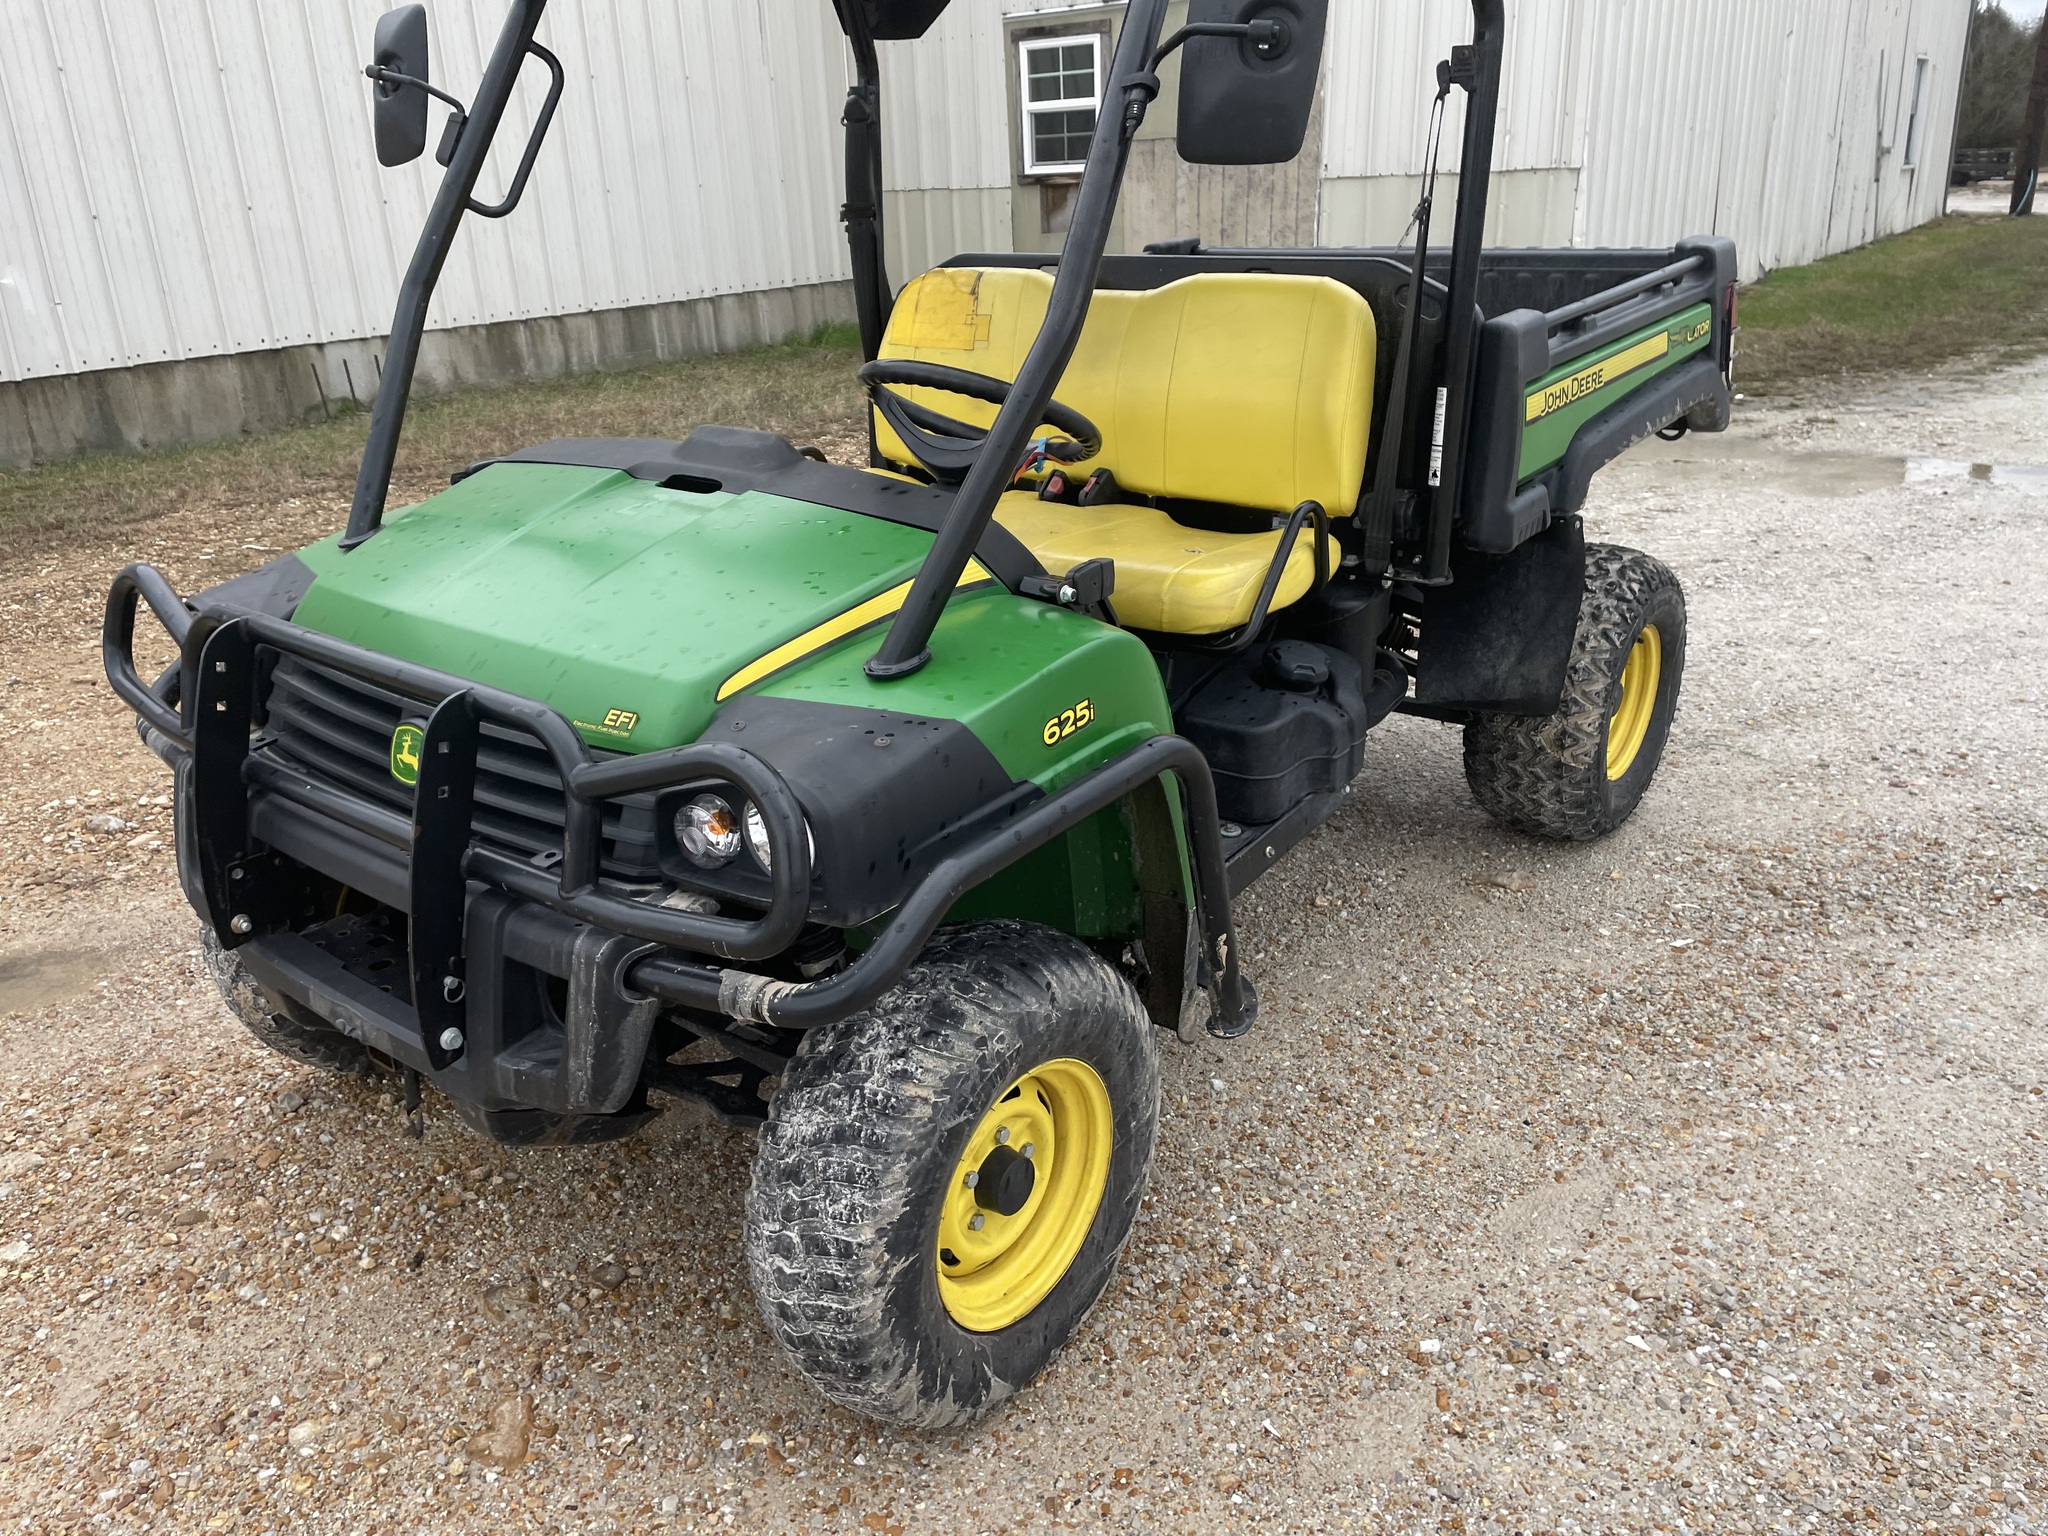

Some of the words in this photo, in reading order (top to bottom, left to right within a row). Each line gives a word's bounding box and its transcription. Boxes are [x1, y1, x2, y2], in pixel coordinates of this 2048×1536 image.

[1540, 385, 1569, 415] JOHN
[1571, 368, 1604, 399] DEERE
[603, 708, 639, 730] EFI
[1043, 697, 1095, 747] 625i
